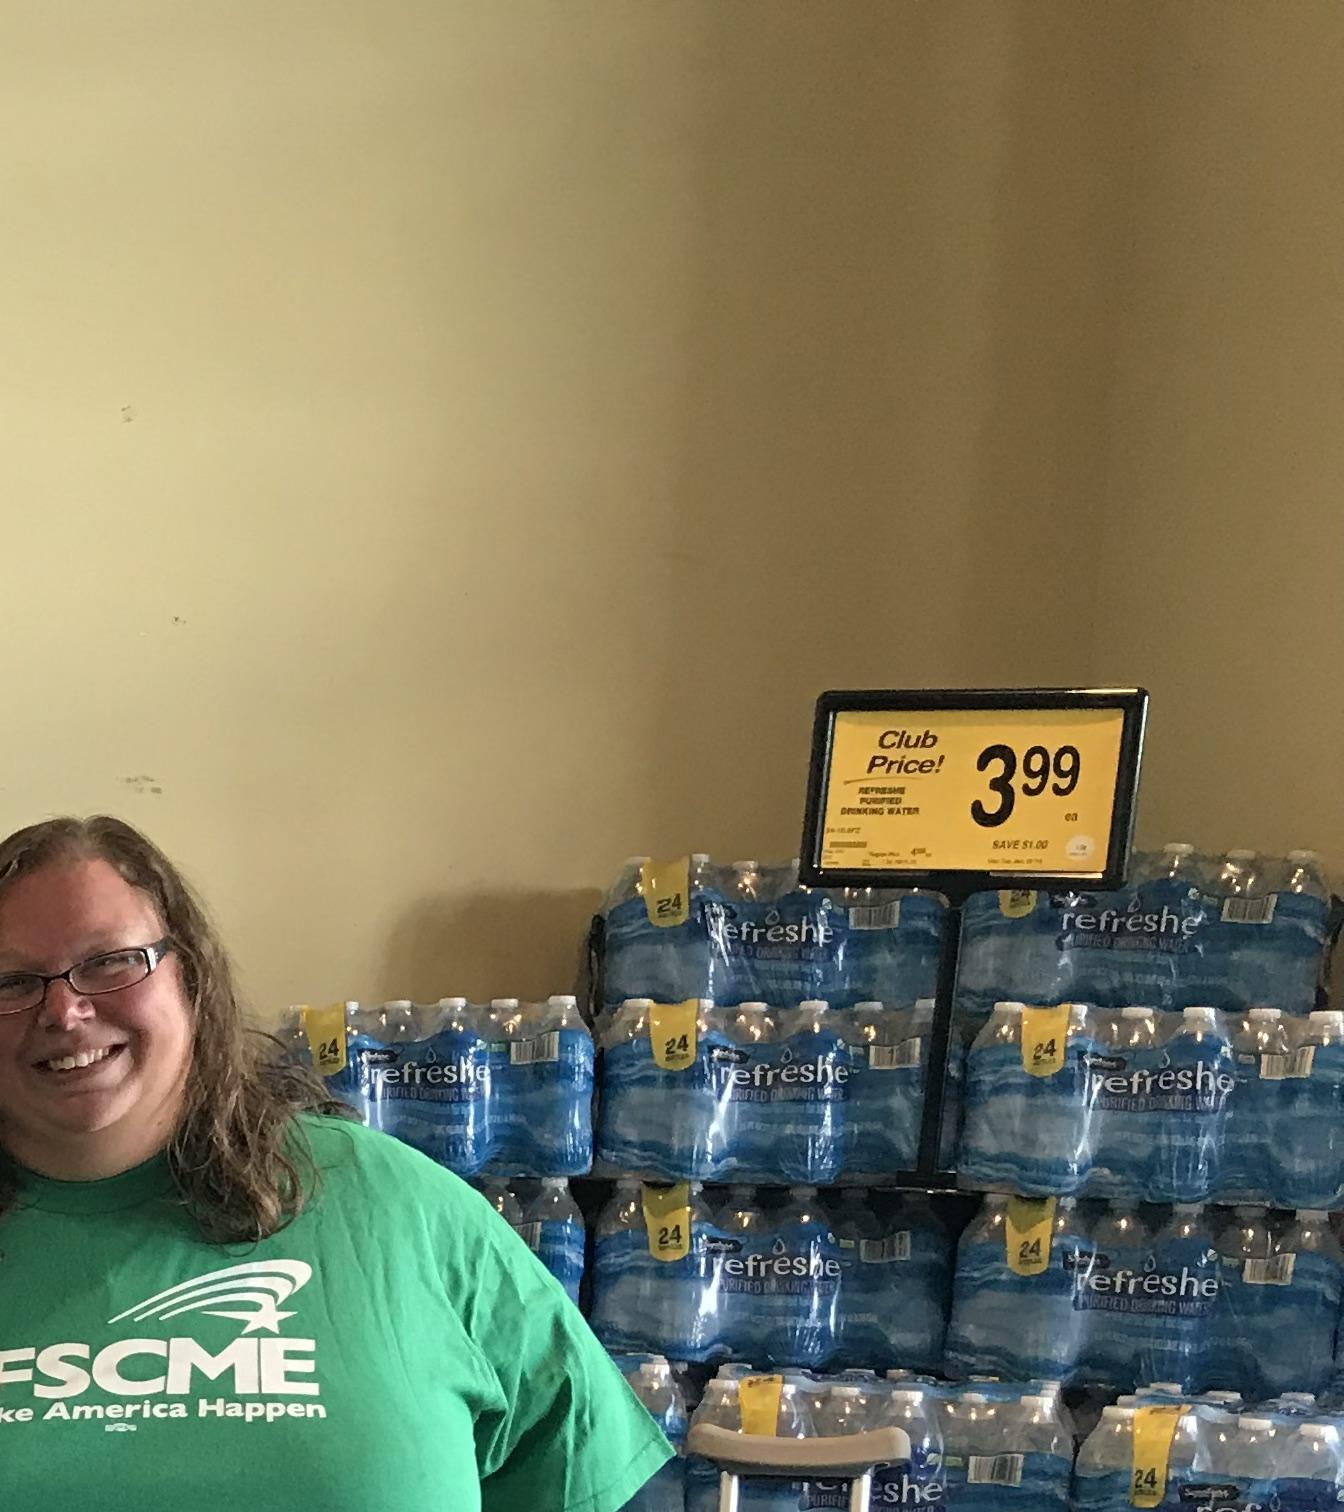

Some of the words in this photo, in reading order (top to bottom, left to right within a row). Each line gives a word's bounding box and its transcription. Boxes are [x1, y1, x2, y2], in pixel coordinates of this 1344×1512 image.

[878, 730, 938, 750] Club
[866, 754, 946, 775] Price!
[887, 807, 920, 816] WATER
[992, 840, 1021, 850] SAVE
[656, 892, 683, 915] 24
[318, 1038, 340, 1058] 24
[664, 1034, 690, 1056] 24
[657, 1224, 683, 1246] 24
[1018, 1238, 1042, 1258] 24
[43, 1400, 189, 1421] America
[198, 1398, 327, 1422] Happen
[1133, 1467, 1158, 1490] 24
